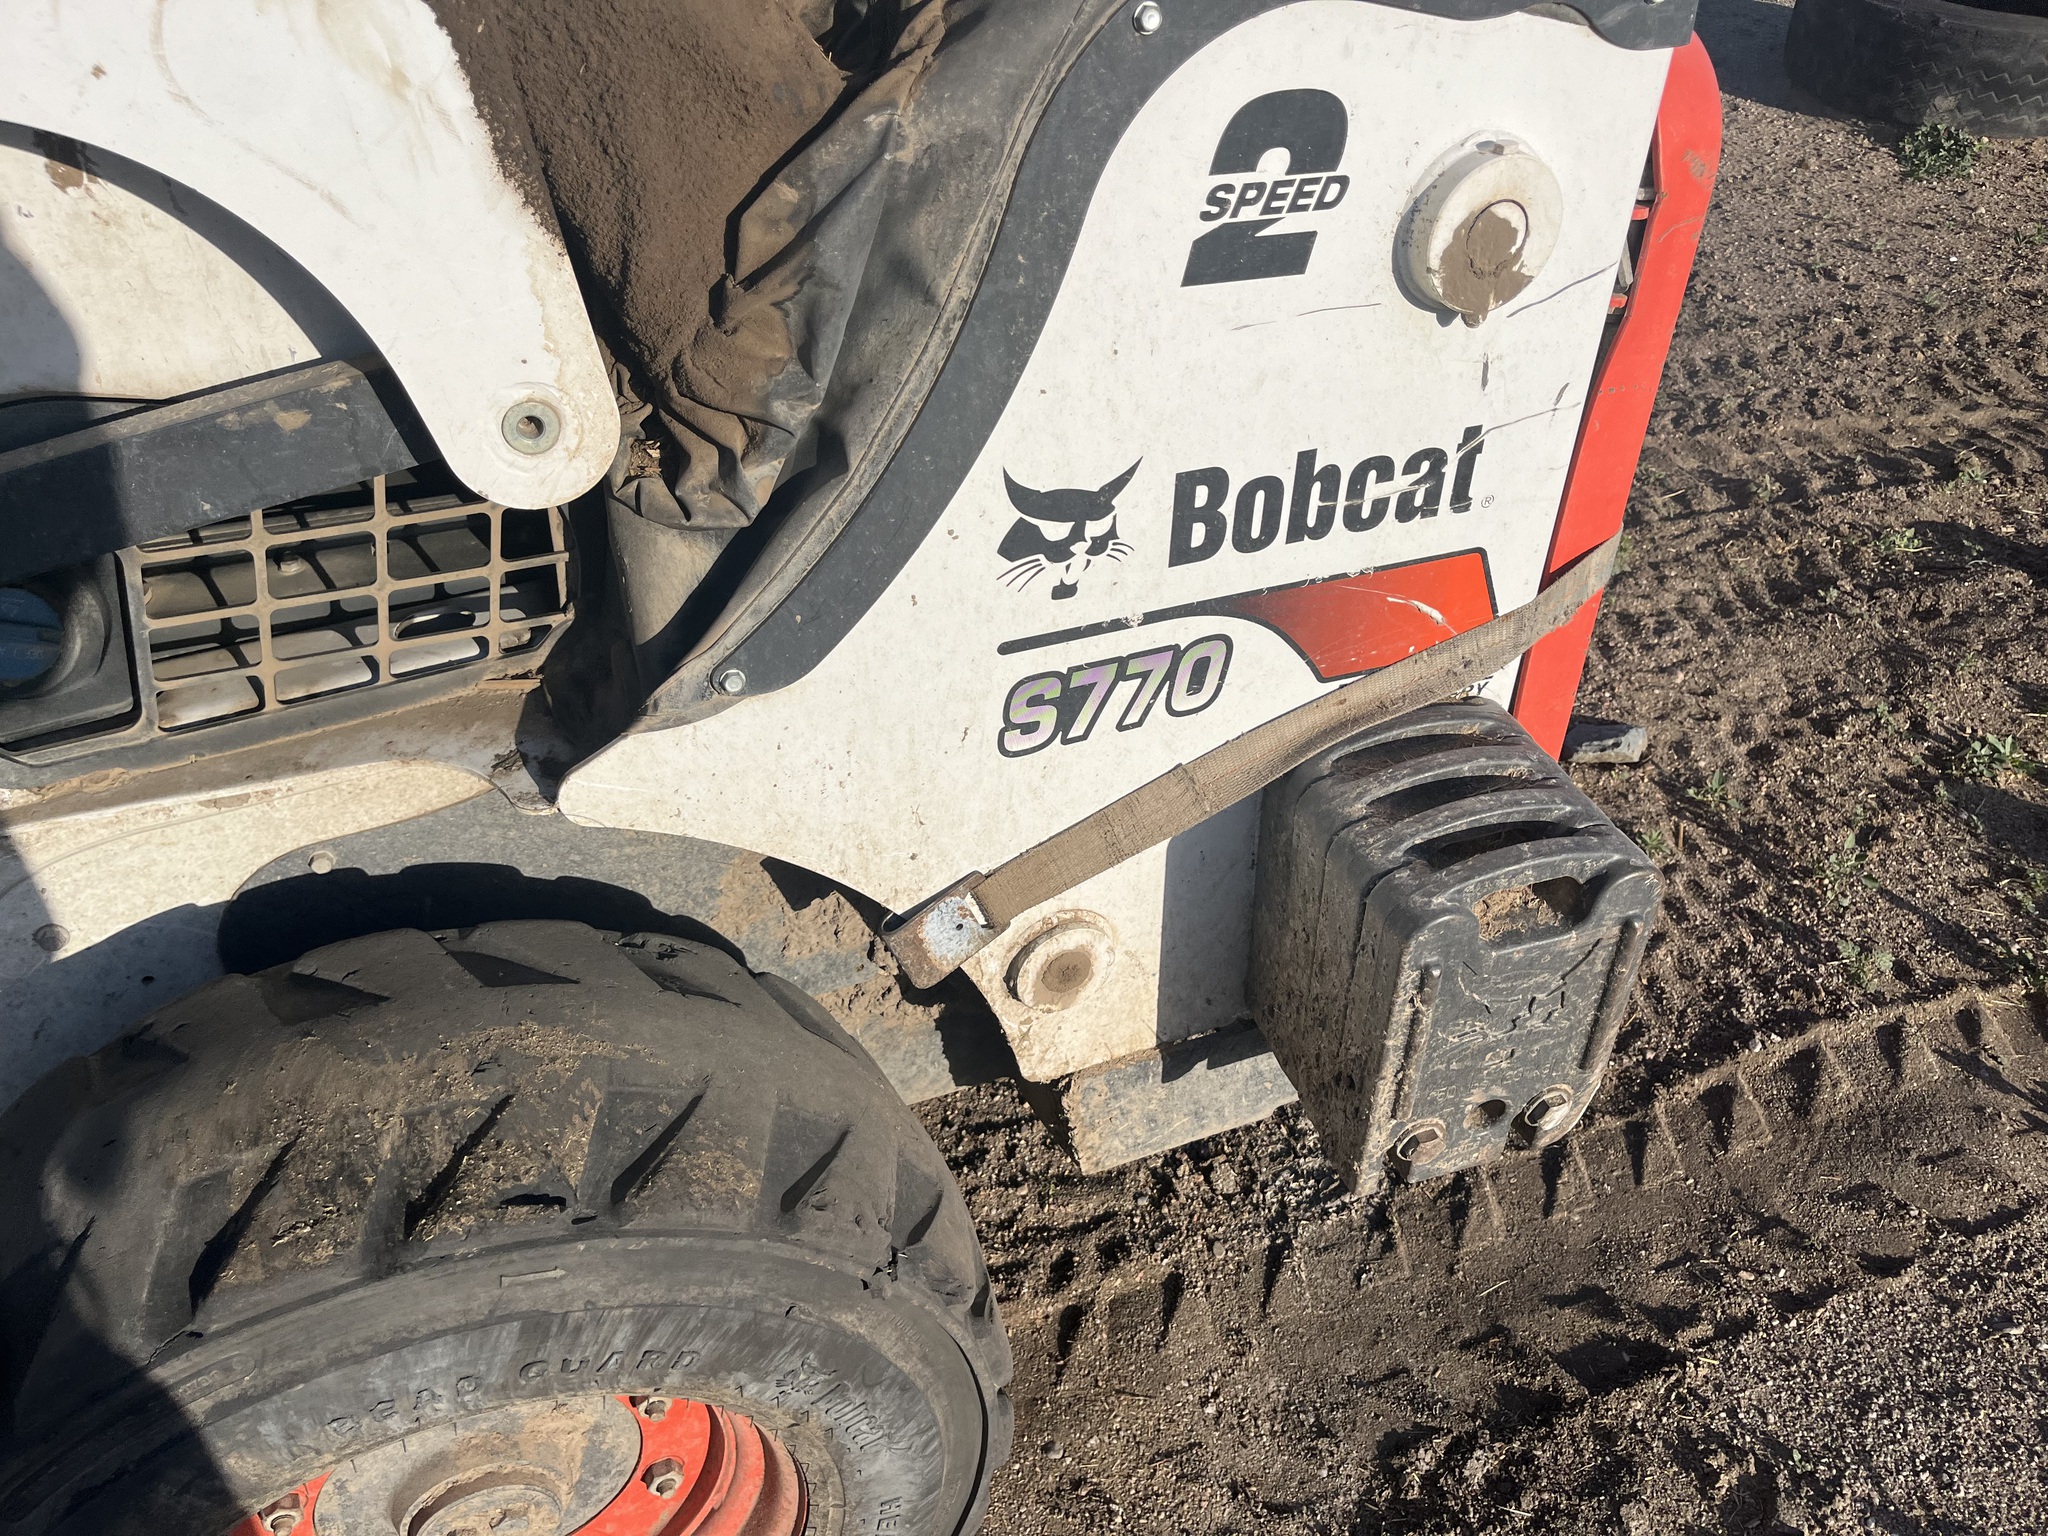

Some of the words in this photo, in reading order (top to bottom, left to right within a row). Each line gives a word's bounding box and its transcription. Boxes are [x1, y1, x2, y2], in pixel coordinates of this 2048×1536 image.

[1199, 174, 1351, 222] SPEED
[1168, 424, 1485, 568] Bobcat
[997, 633, 1234, 758] S770
[519, 1350, 702, 1382] GUARD
